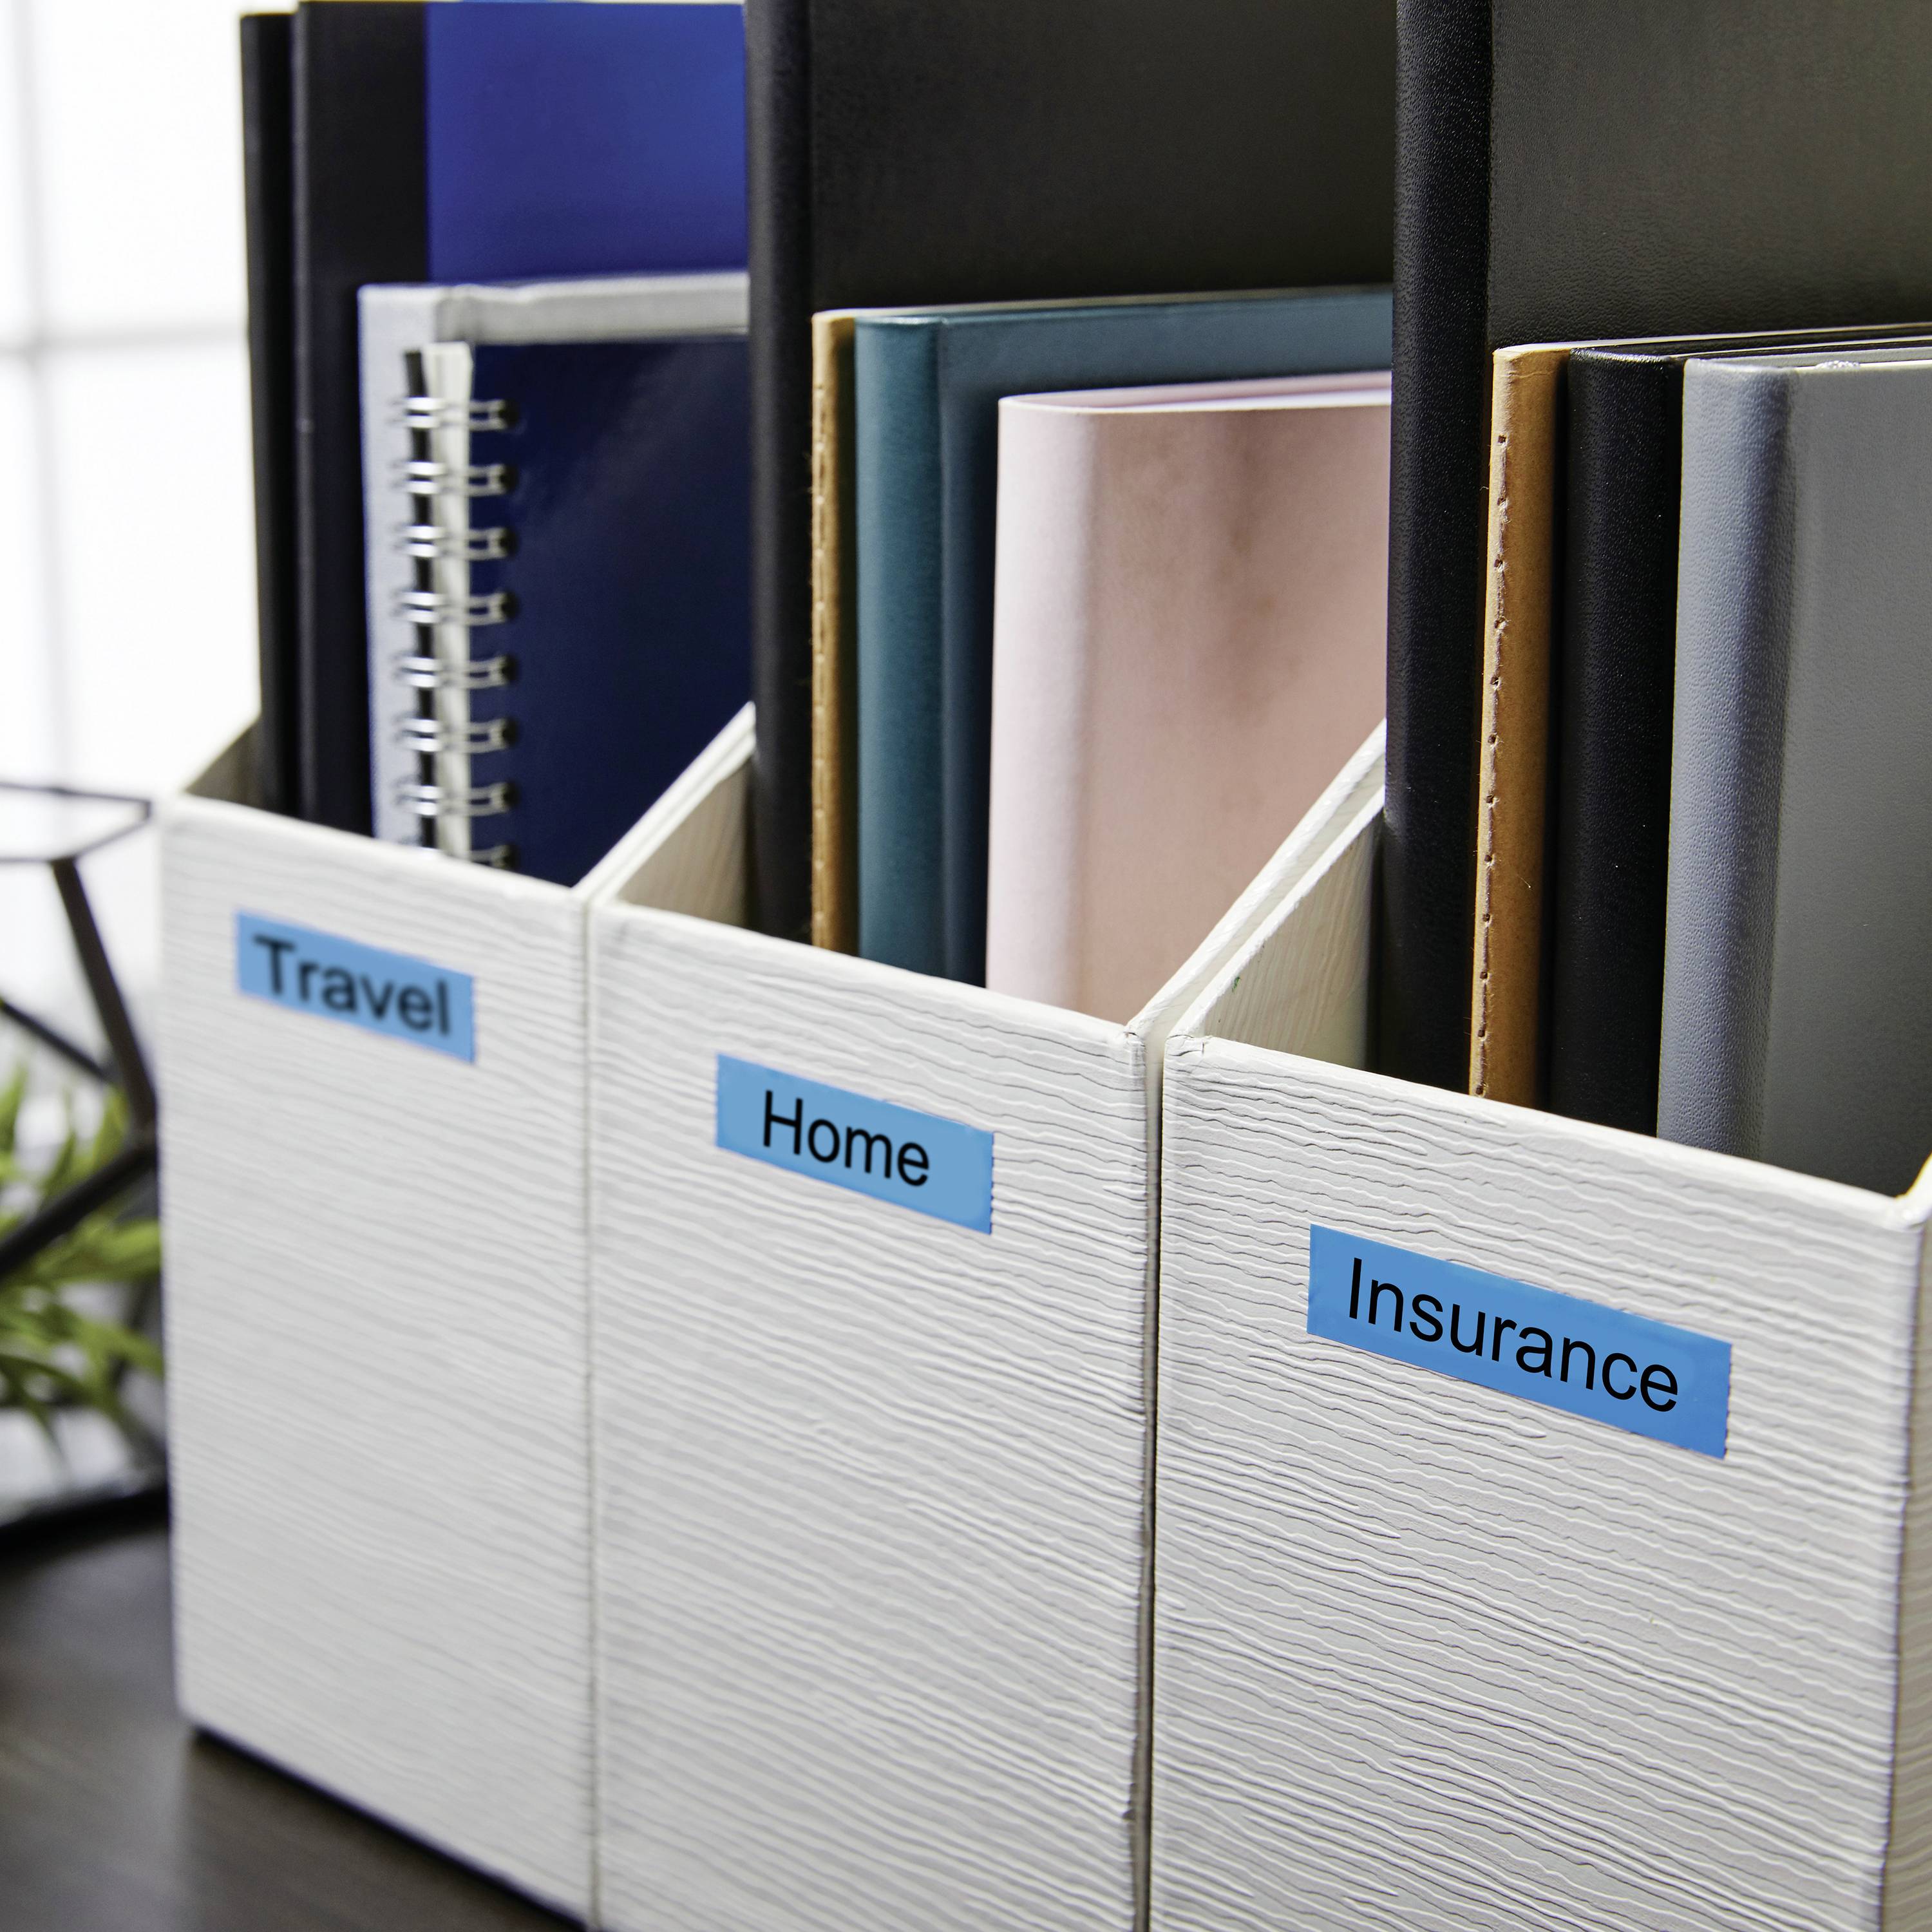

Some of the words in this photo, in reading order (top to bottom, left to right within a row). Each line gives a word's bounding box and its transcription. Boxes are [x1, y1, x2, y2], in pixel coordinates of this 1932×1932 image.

[254, 935, 450, 1035] Travel
[762, 1090, 930, 1187] Home
[1349, 1256, 1679, 1412] Insurance
